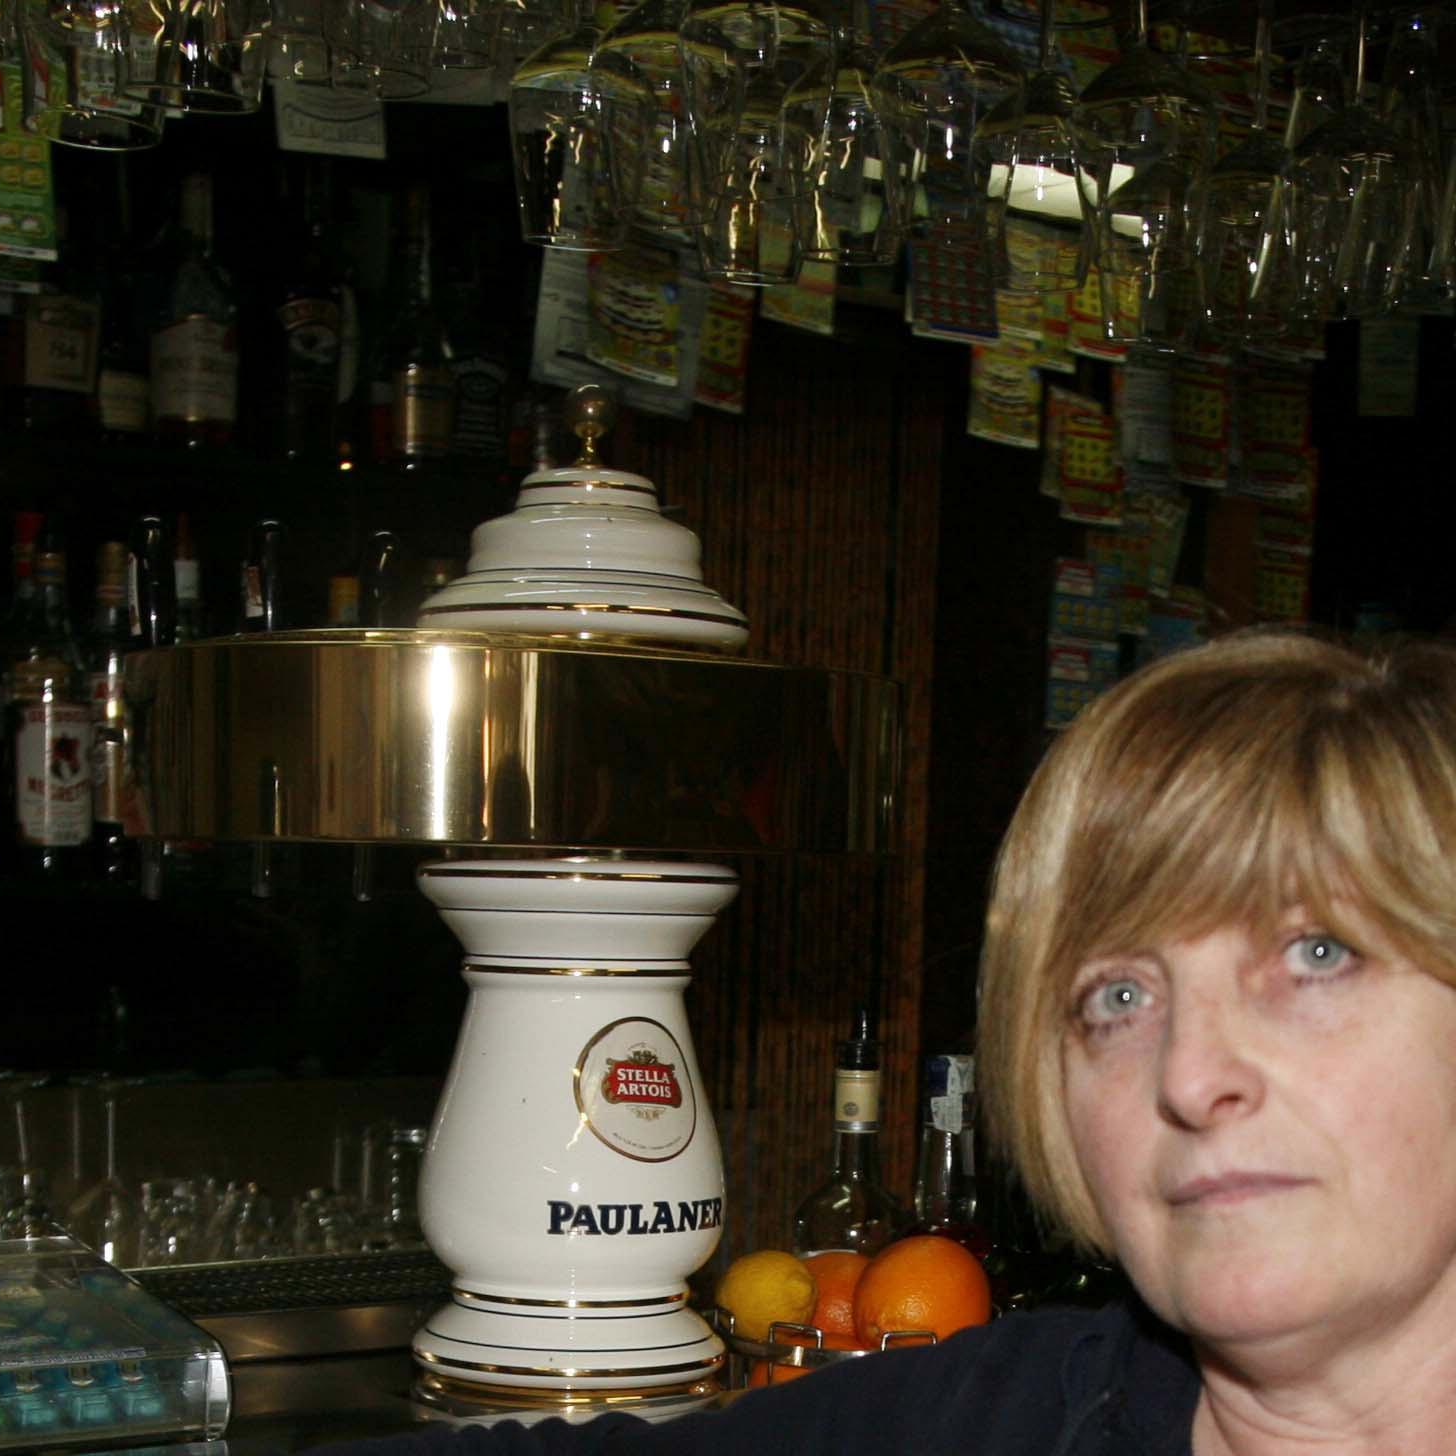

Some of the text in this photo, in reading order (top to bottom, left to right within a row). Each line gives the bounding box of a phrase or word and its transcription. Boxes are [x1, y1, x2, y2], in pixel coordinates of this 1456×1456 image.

[616, 1067, 671, 1084] STELLA
[616, 1082, 672, 1099] ARTOIS
[547, 1197, 723, 1236] PAULANER
